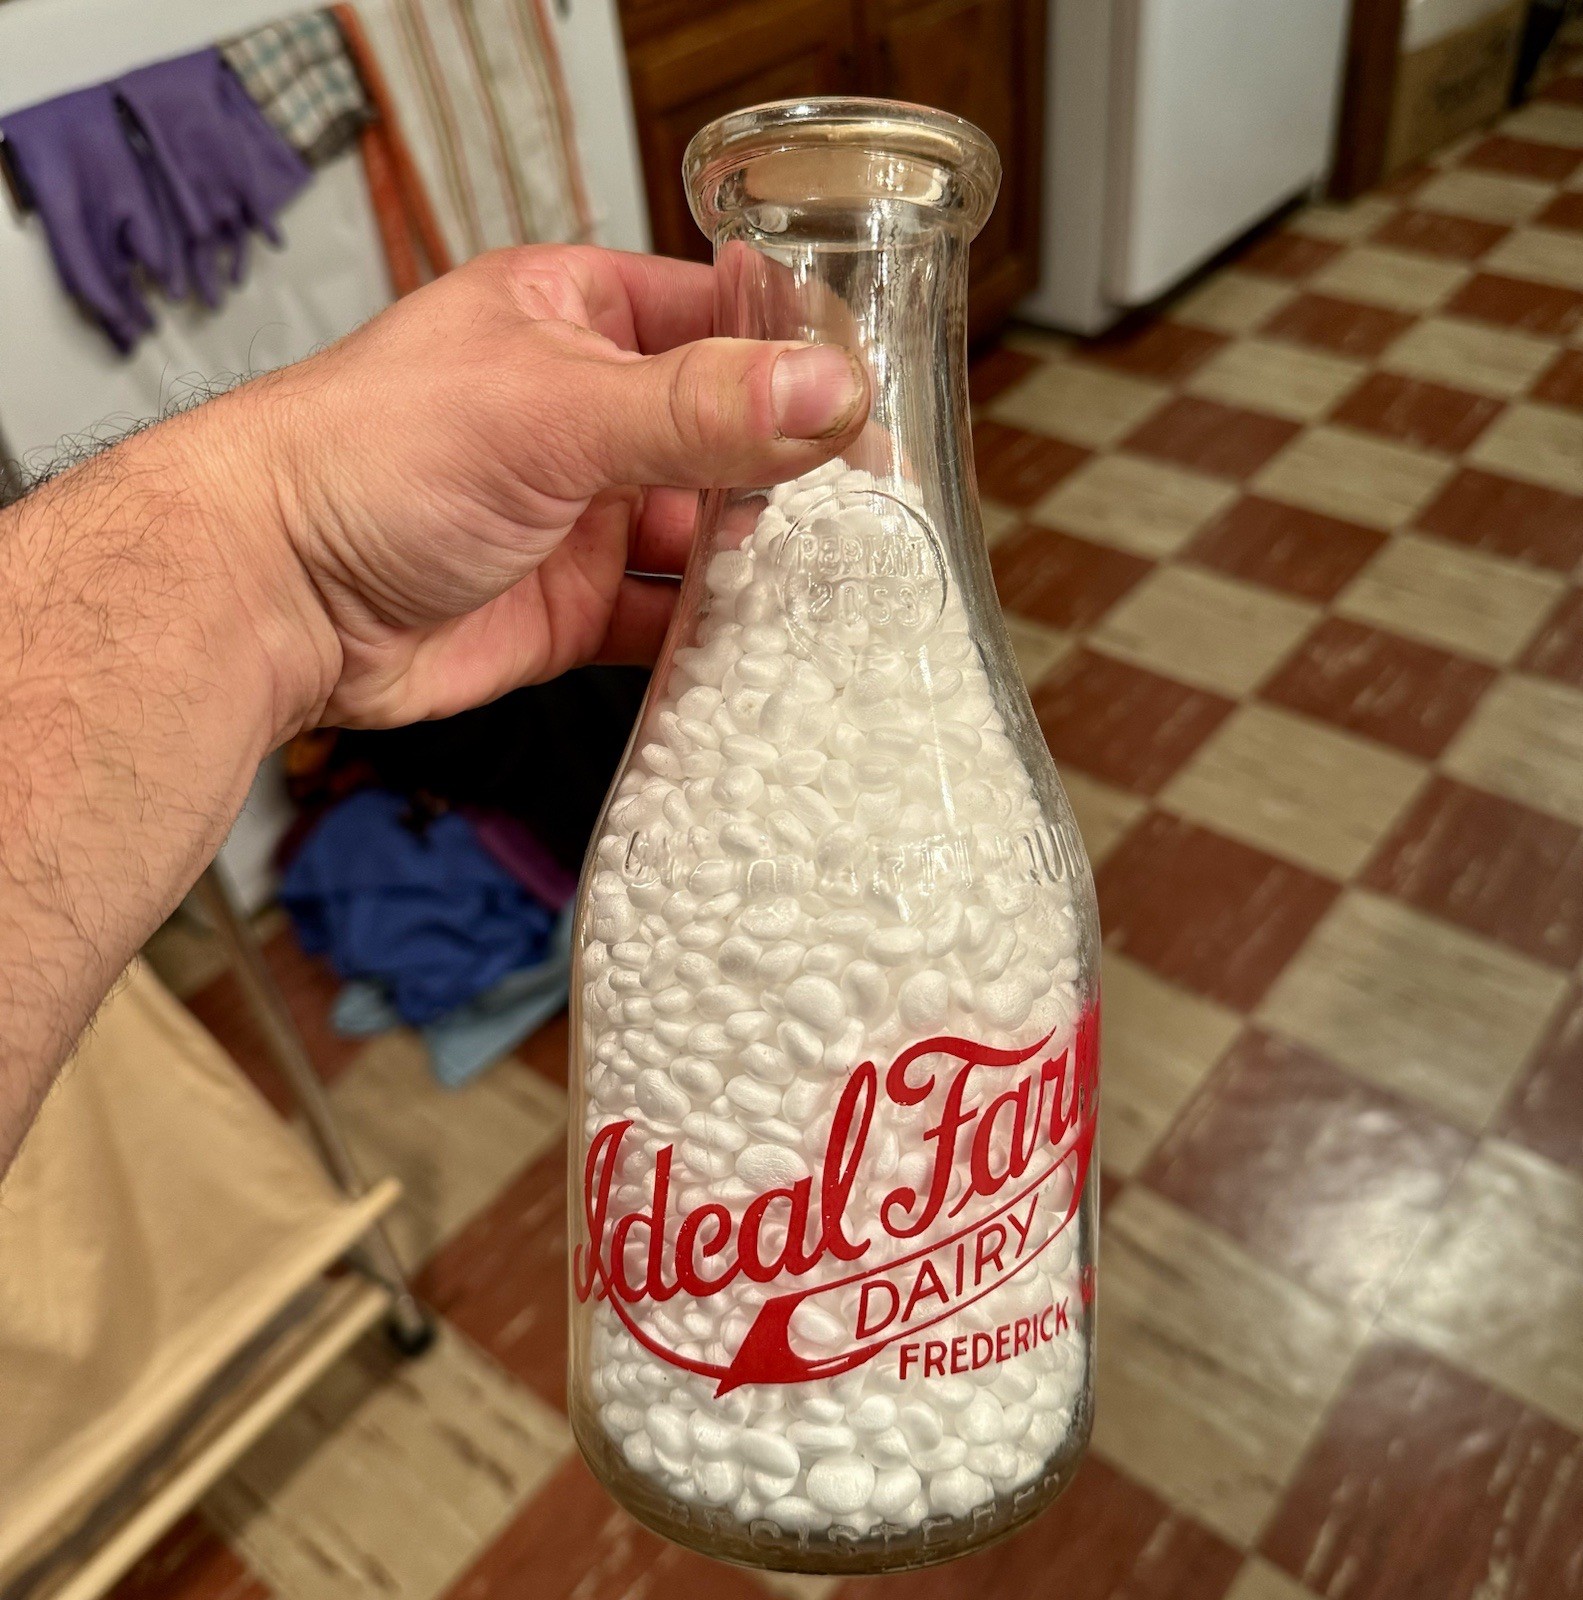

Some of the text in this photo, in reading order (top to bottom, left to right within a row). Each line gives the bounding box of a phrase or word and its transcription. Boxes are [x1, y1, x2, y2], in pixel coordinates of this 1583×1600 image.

[798, 533, 924, 578] PERMIT
[574, 1060, 877, 1304] Ideal
[855, 1192, 1039, 1340] DAIRY
